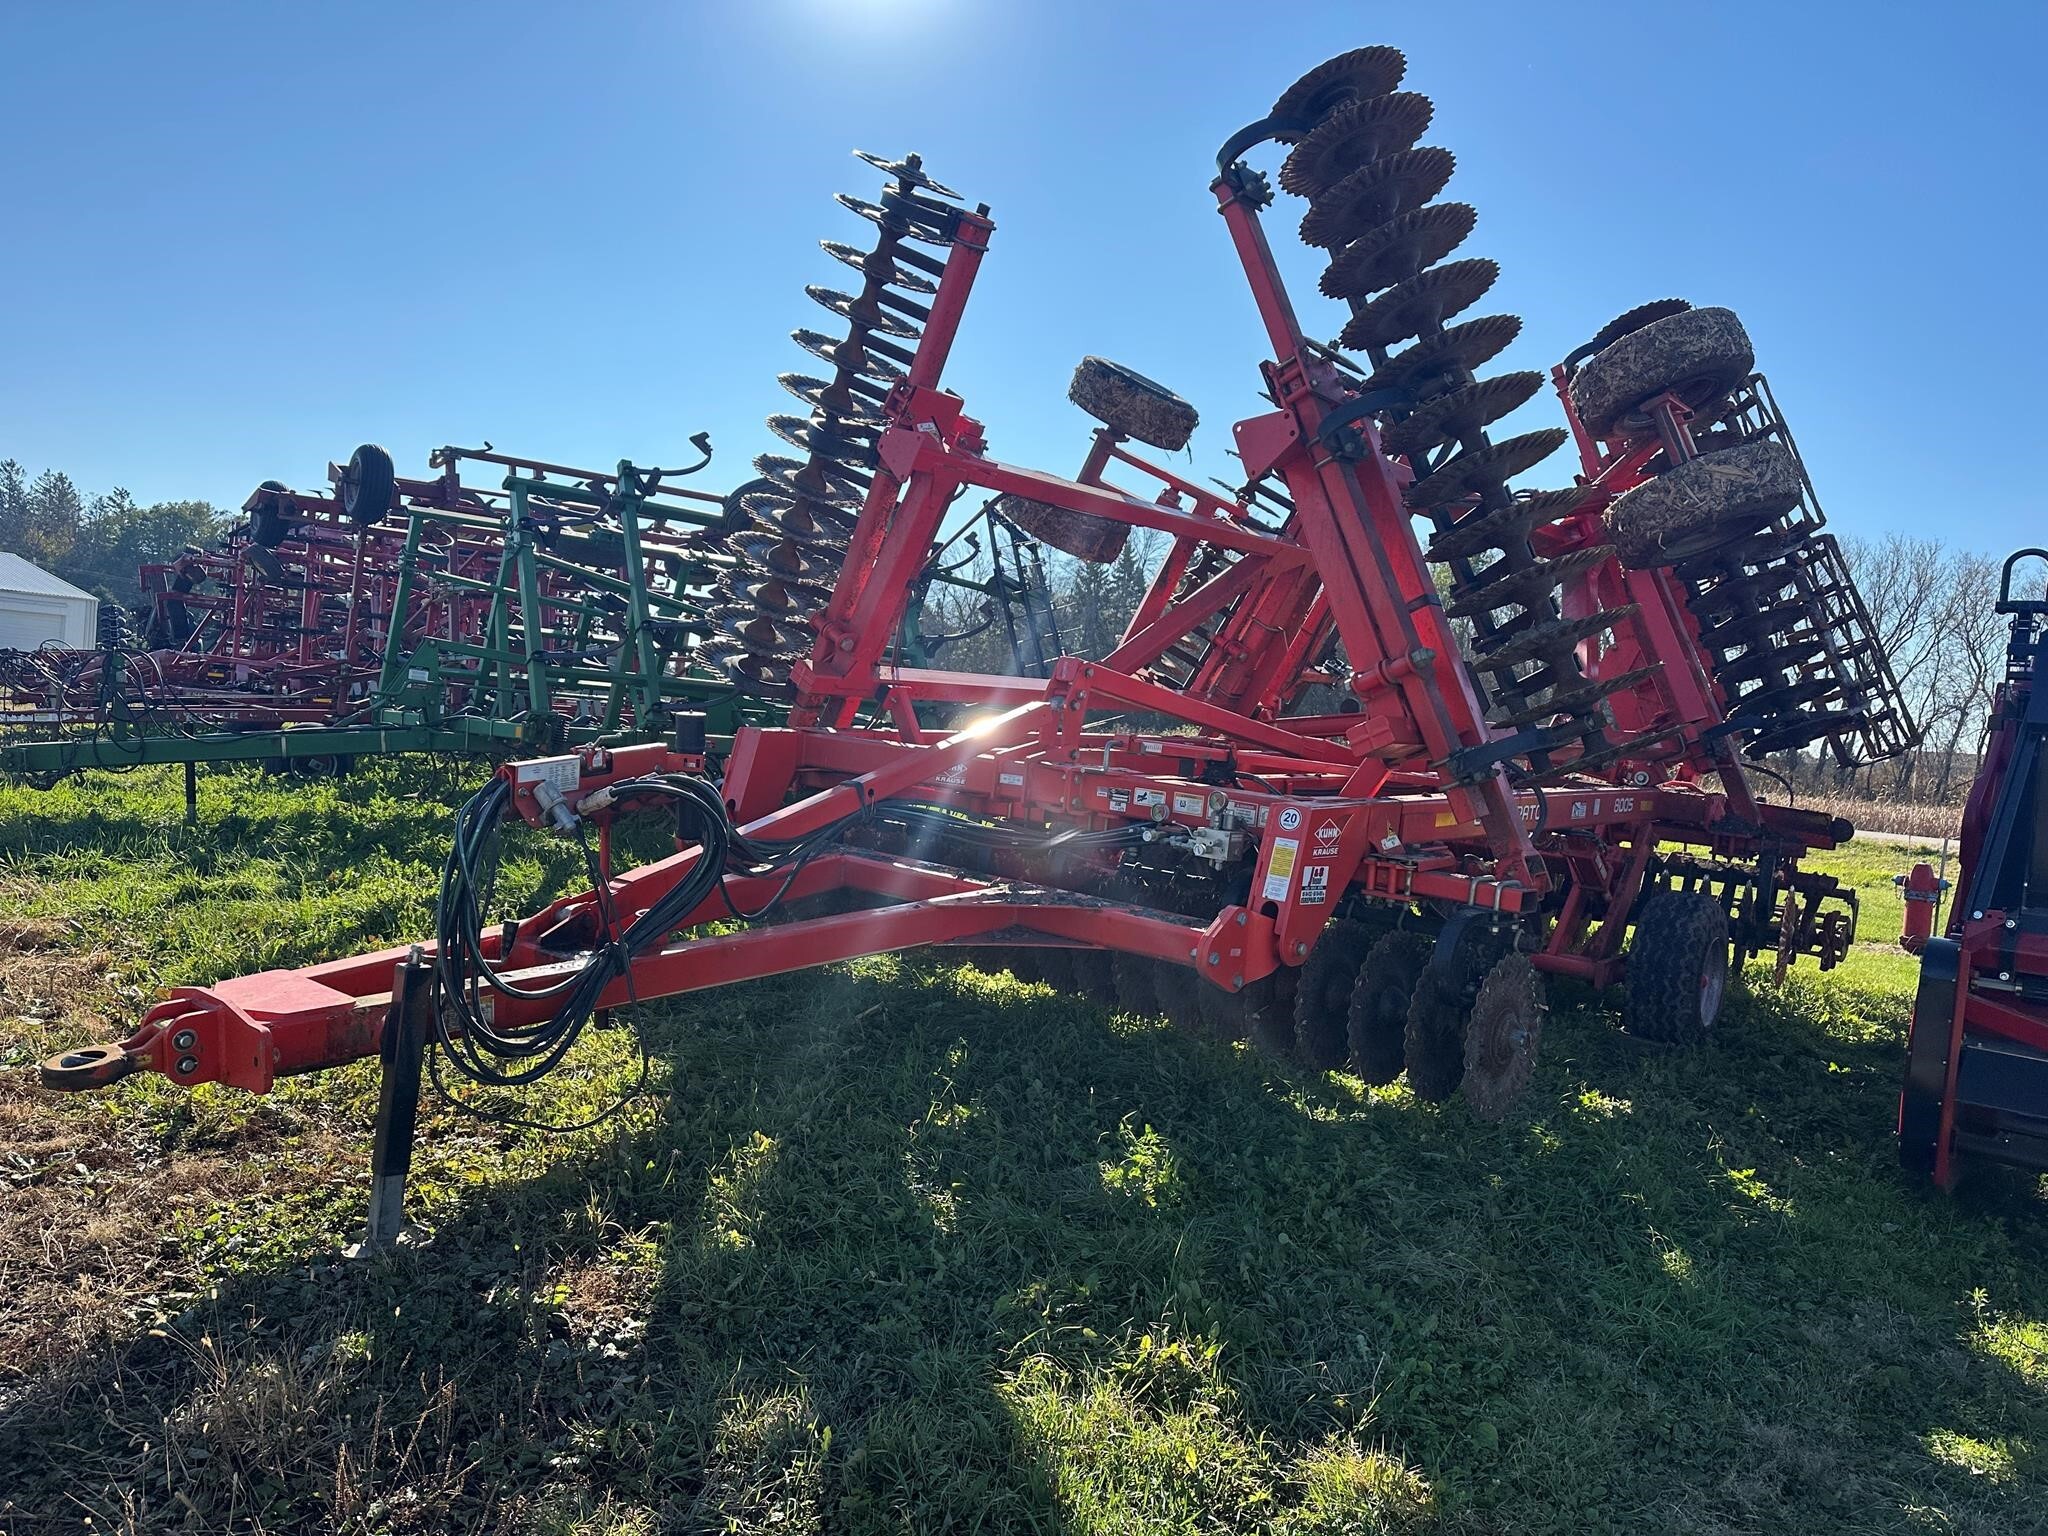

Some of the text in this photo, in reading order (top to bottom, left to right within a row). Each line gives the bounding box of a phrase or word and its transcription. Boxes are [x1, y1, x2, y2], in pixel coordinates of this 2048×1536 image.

[935, 776, 966, 785] KRAUSE
[1613, 797, 1634, 813] 8005
[1283, 812, 1298, 823] 20
[1318, 828, 1338, 839] KUHN
[1312, 847, 1339, 856] KRAUSE
